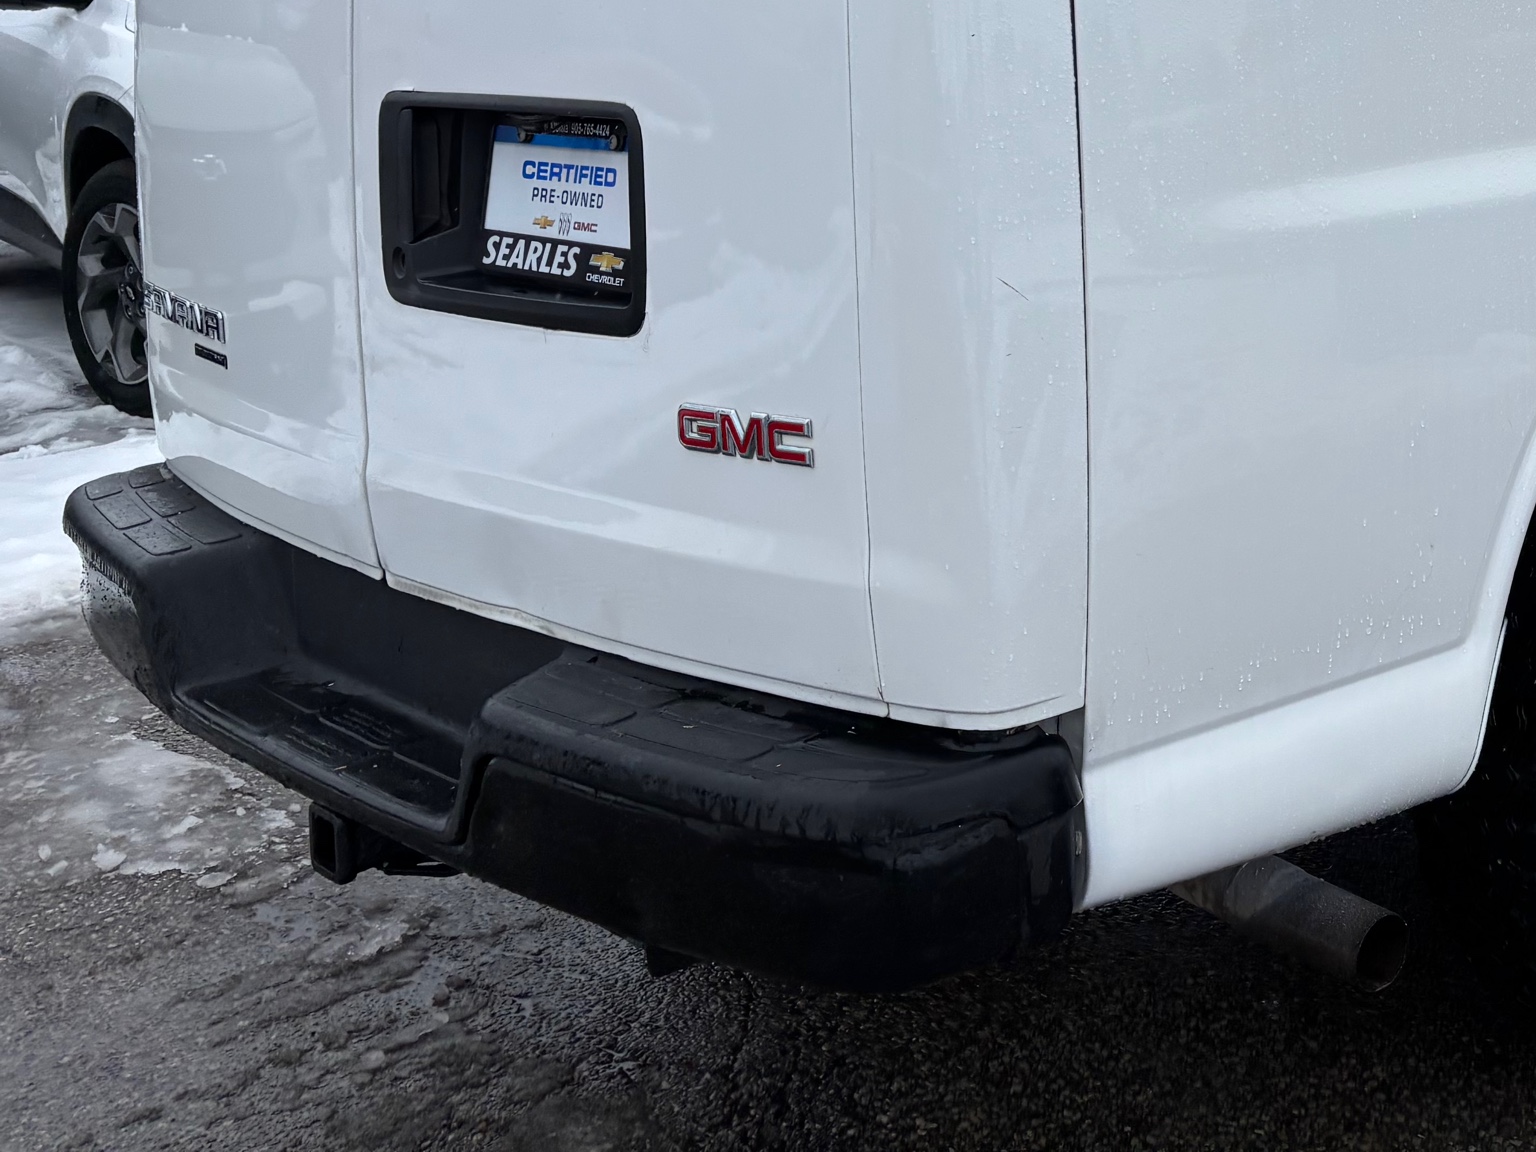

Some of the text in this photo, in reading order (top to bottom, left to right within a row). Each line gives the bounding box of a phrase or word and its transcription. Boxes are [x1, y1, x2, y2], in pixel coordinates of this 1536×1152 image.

[570, 122, 610, 137] 905-765-4424
[521, 160, 617, 187] CERTIFIED
[531, 187, 604, 209] PRE-OWNED
[572, 221, 598, 233] GMC
[481, 235, 581, 277] SEARLES
[585, 273, 625, 287] CHEVROLET
[677, 401, 815, 469] GMC
